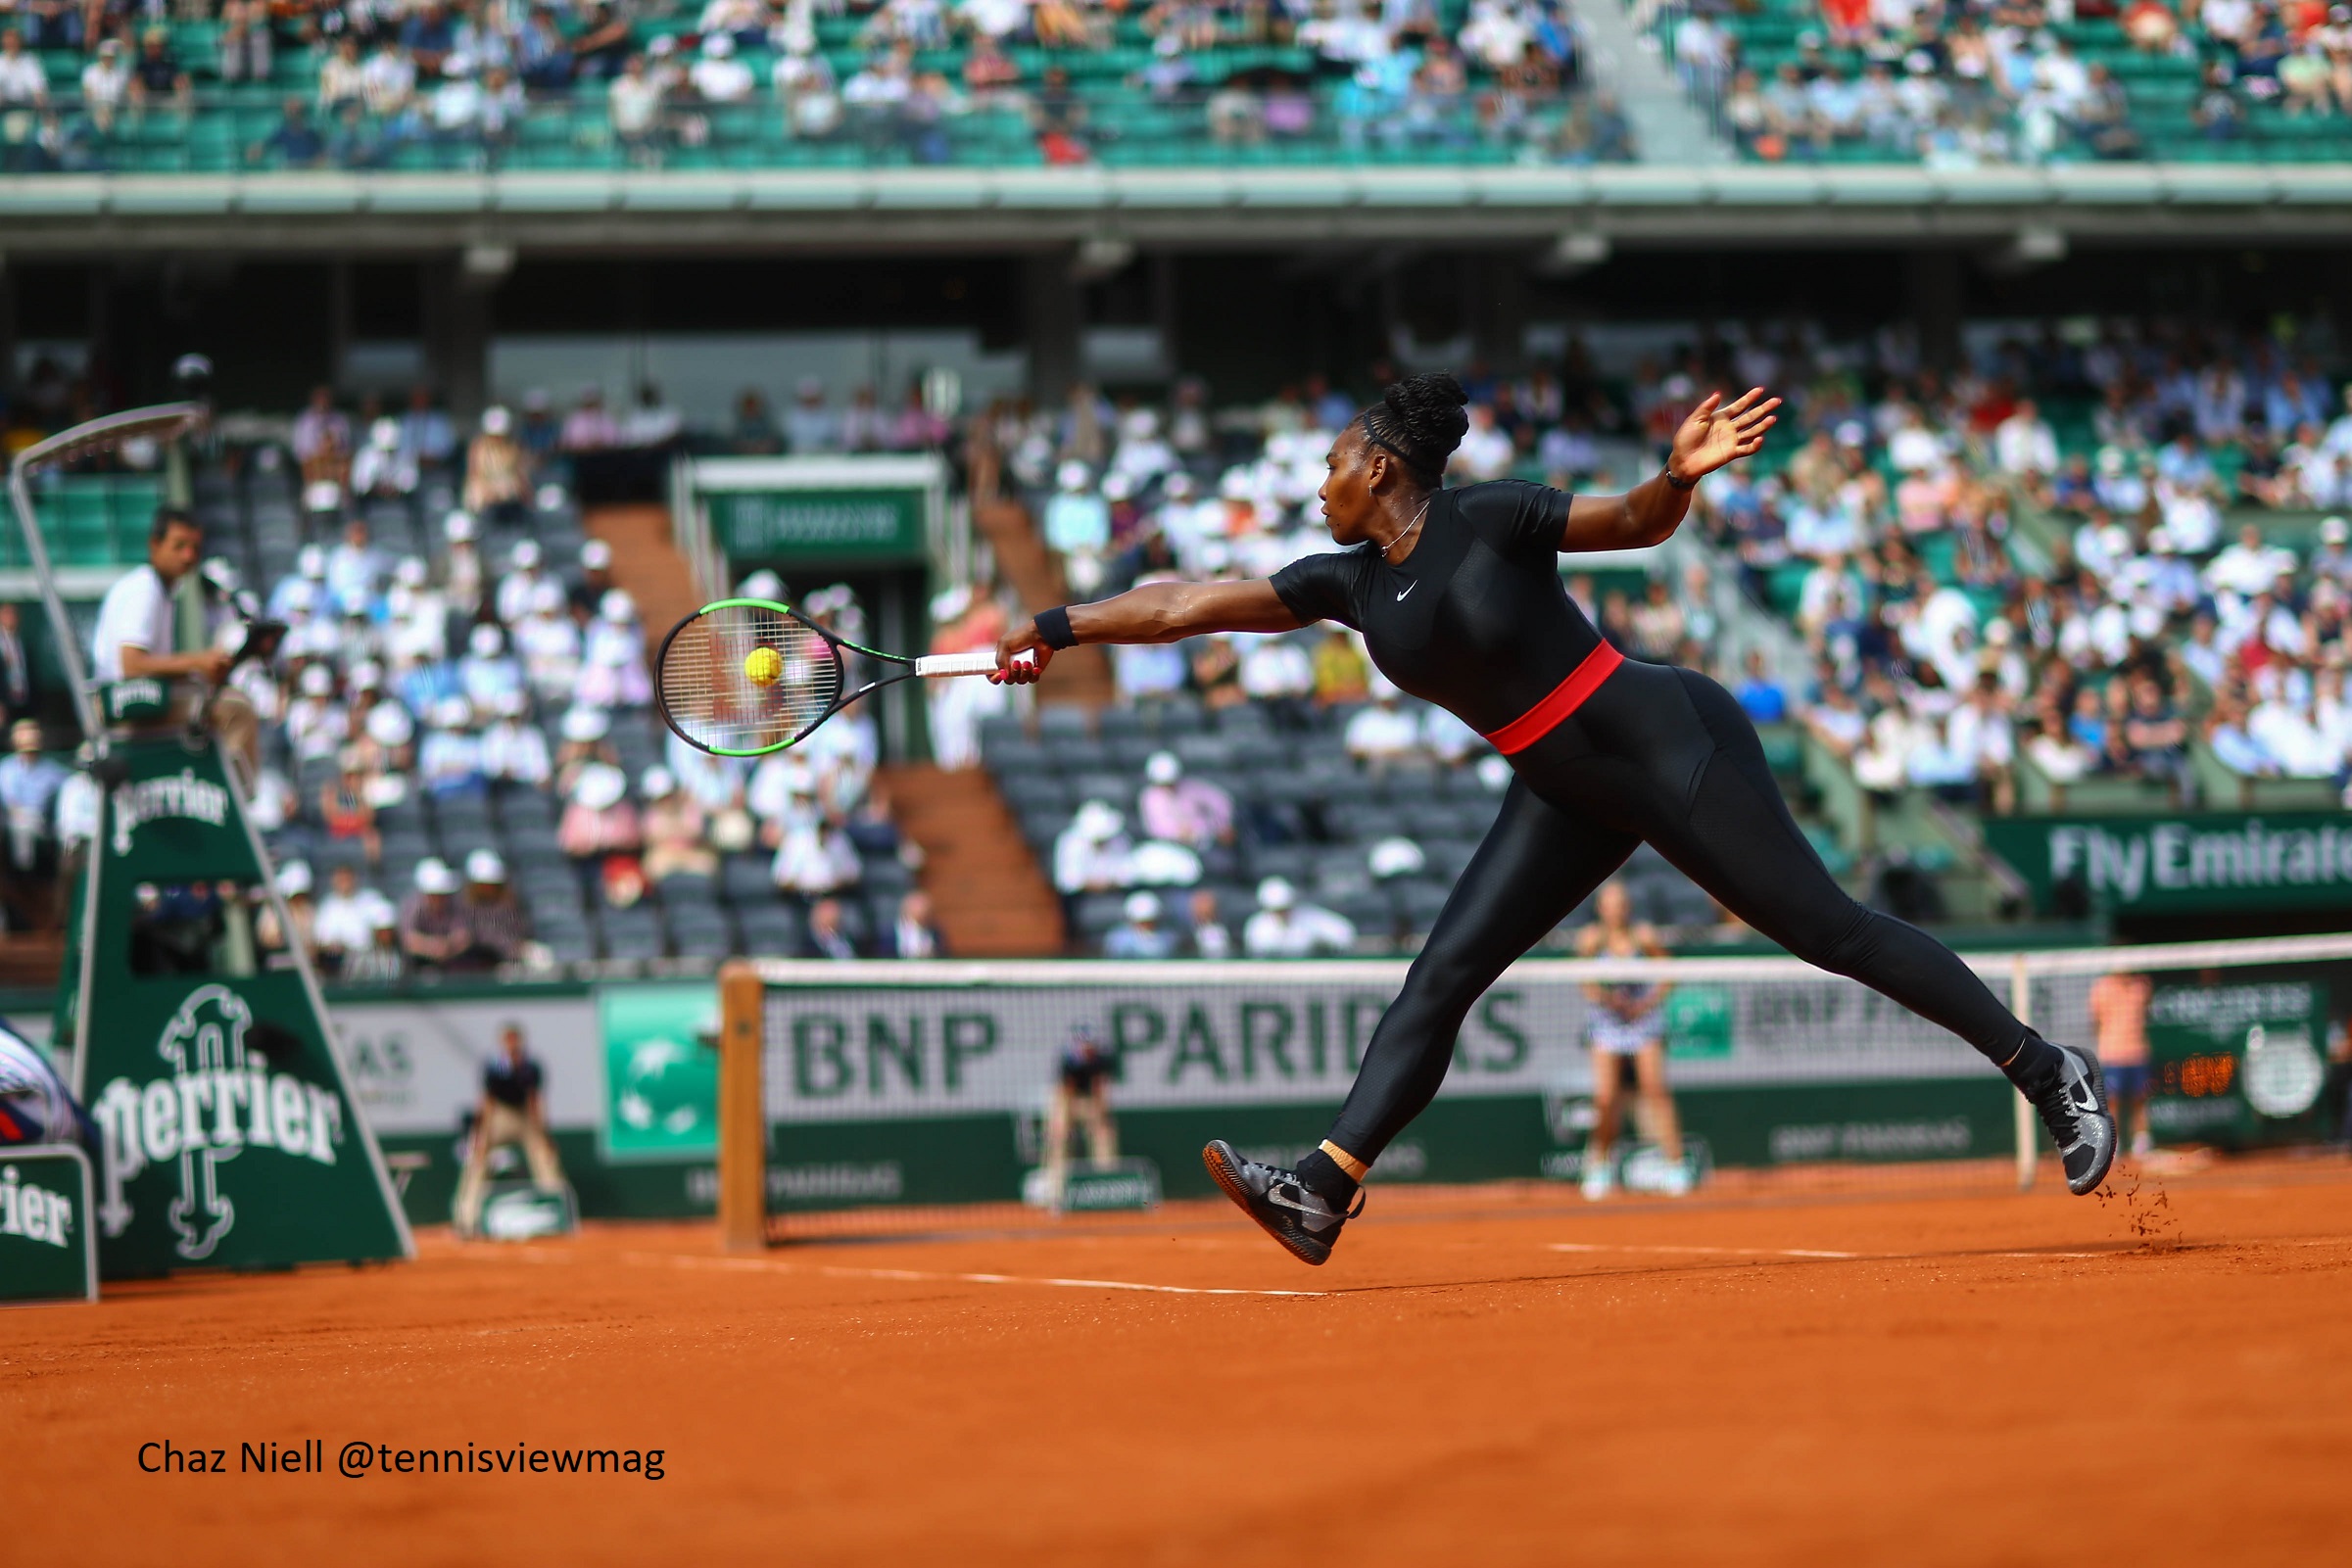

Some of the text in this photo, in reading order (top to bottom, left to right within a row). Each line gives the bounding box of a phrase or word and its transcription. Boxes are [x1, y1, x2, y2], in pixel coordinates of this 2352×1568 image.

[2049, 825, 2146, 901] Fly
[792, 990, 1529, 1098] BNP PARIBS
[0, 1164, 72, 1248] ier
